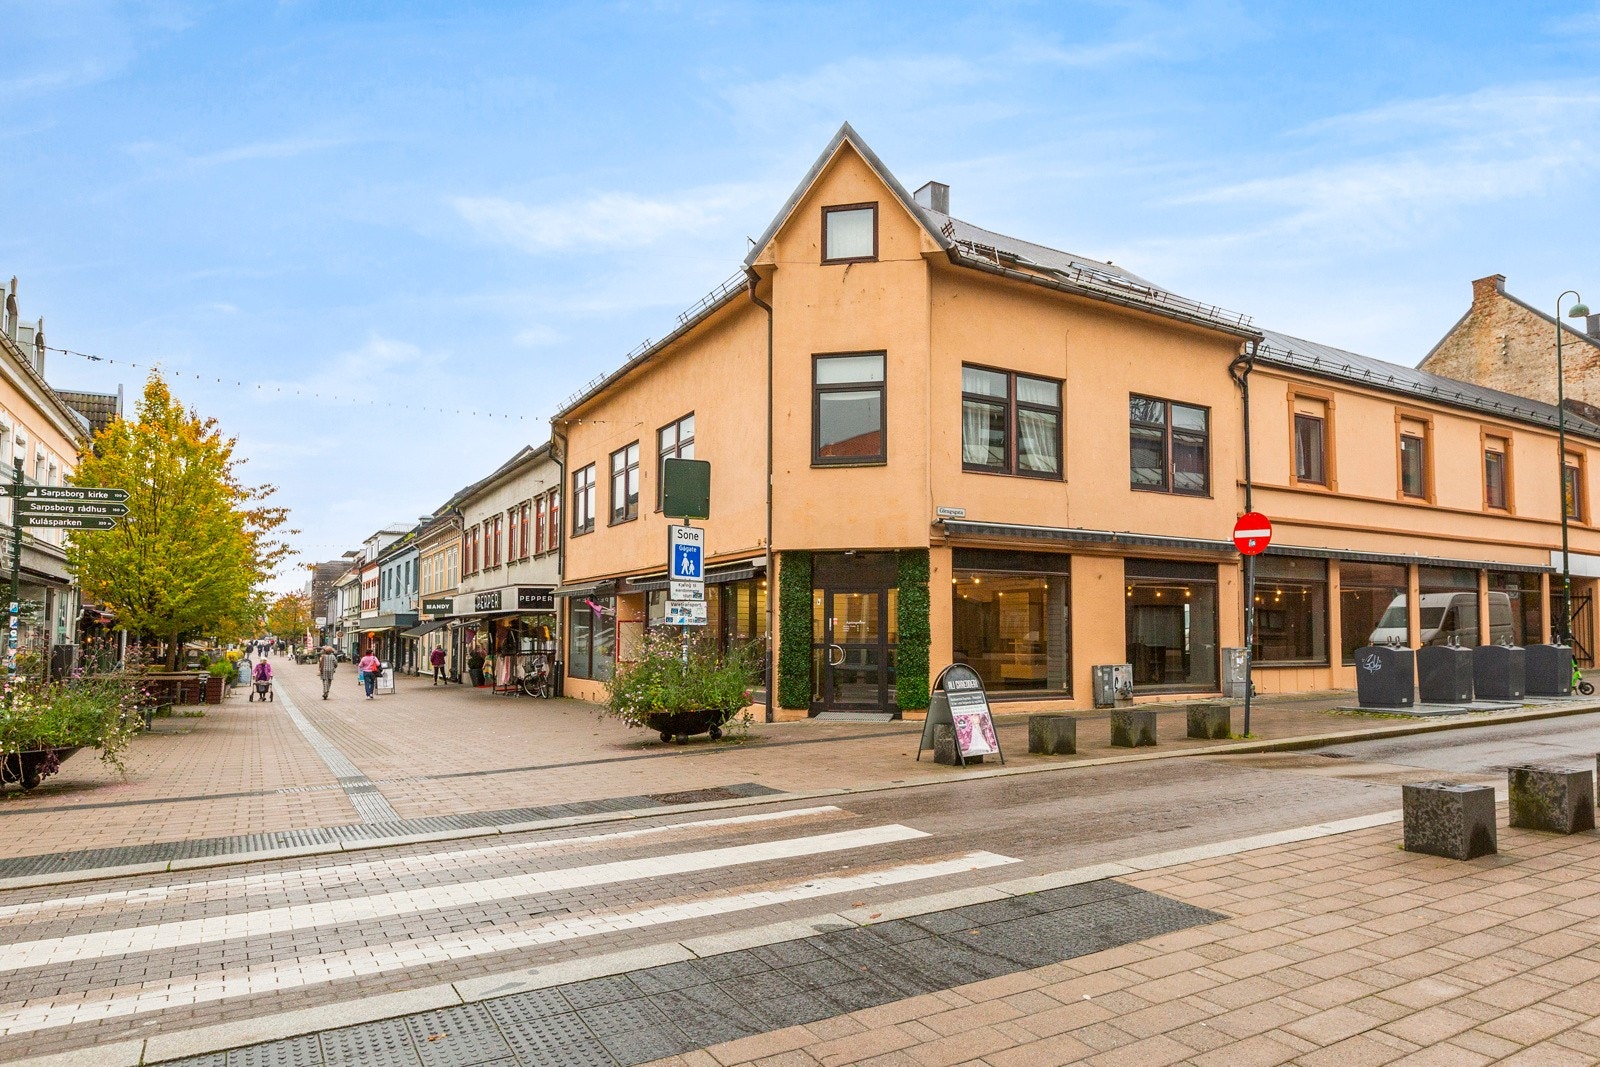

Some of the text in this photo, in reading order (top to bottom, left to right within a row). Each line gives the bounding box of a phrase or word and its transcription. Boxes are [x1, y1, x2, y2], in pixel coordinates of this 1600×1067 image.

[41, 488, 84, 499] Sarpsborg
[88, 491, 109, 499] kirke
[30, 503, 74, 512] Sarpsborg
[78, 504, 107, 513] rådhus
[29, 517, 82, 527] Kulåsparken
[677, 529, 699, 541] Sone
[678, 544, 697, 553] Gågate
[475, 592, 499, 610] PEPPER
